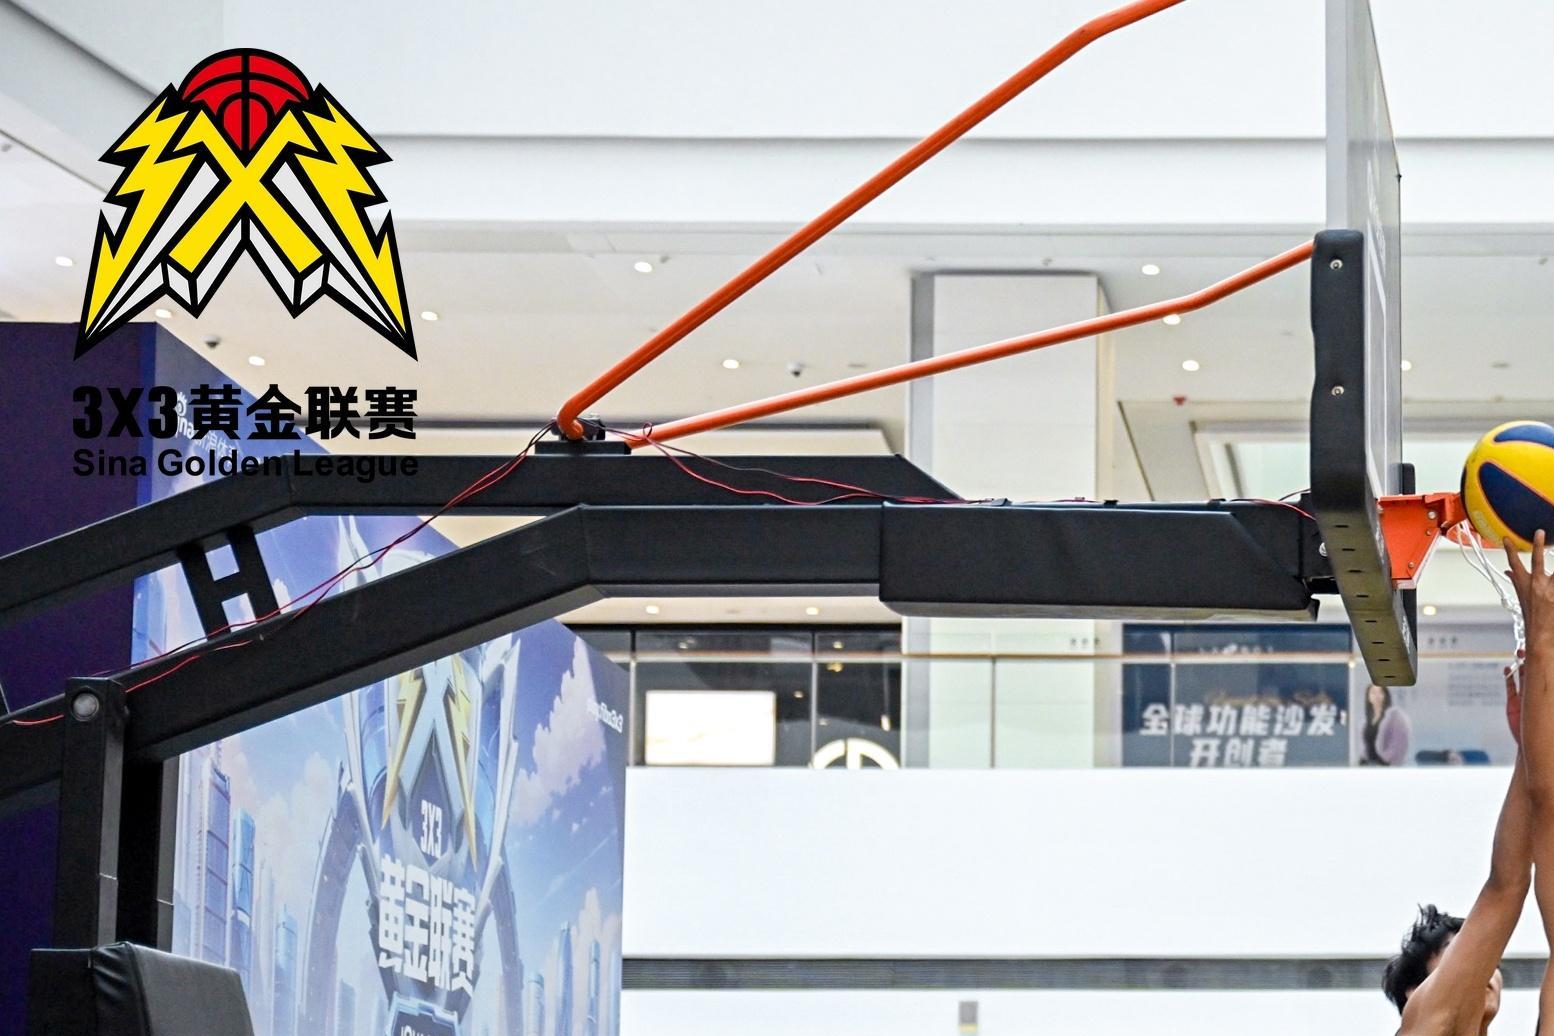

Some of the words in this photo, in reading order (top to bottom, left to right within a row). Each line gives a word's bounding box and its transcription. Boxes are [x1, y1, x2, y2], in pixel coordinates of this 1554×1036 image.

[421, 799, 443, 860] 3X3
[379, 853, 476, 999] 黄金联赛
